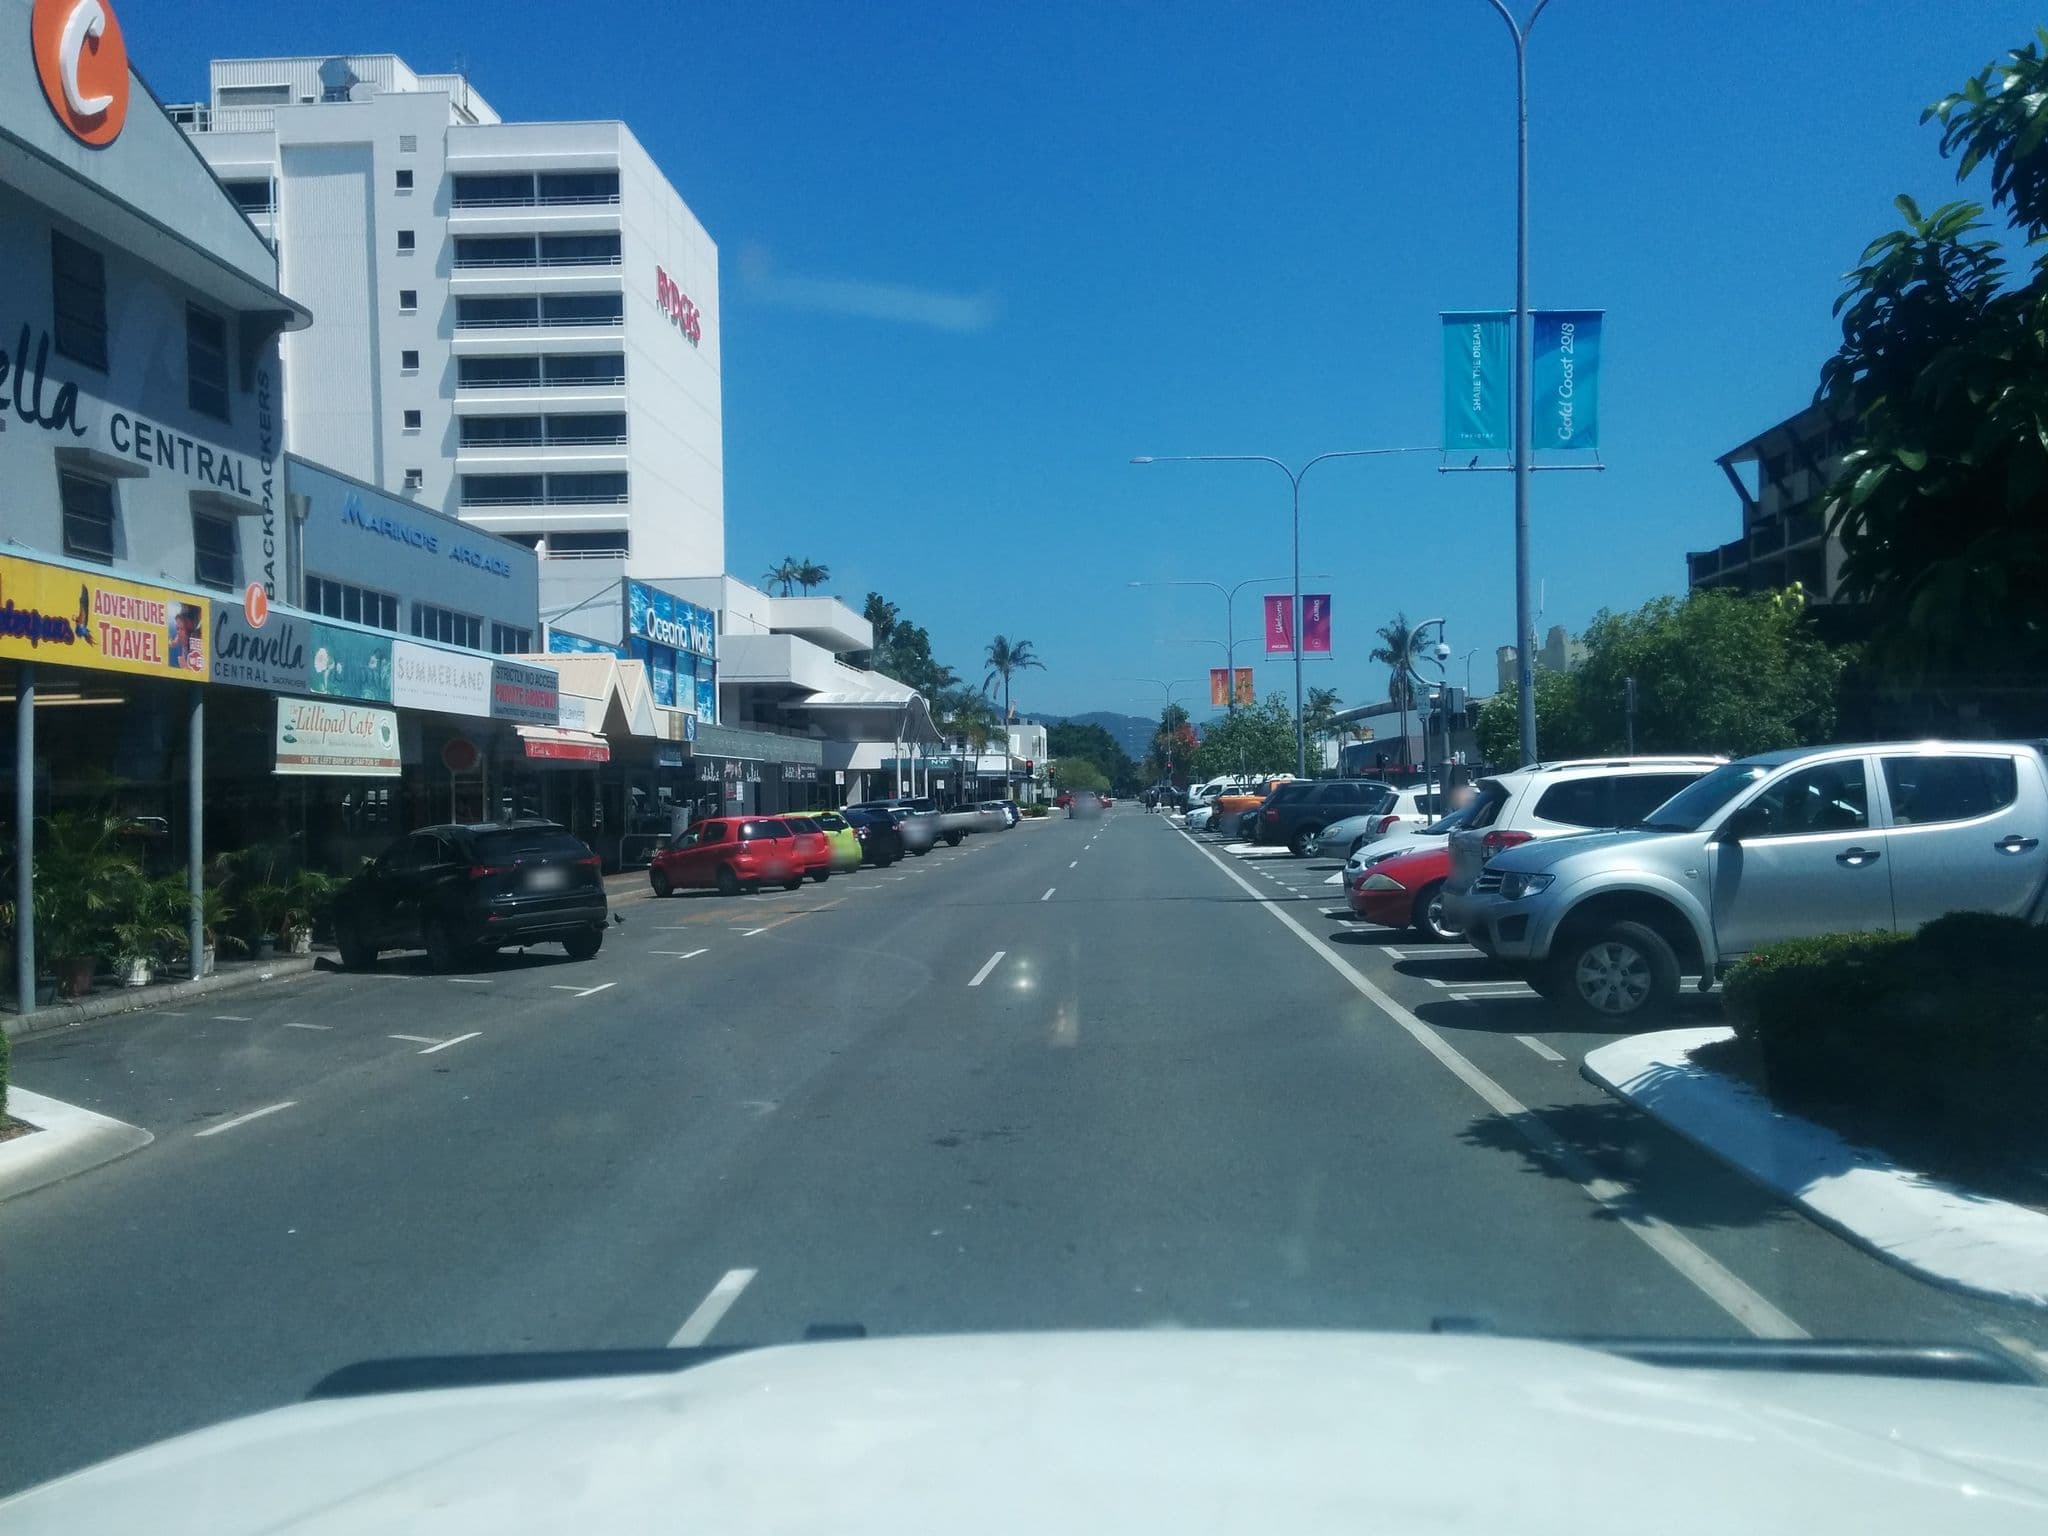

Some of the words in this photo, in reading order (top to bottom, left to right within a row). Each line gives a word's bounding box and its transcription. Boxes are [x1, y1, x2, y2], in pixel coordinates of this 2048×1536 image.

[656, 264, 701, 343] RYDGES
[1472, 323, 1481, 358] DREAM
[1560, 322, 1575, 354] 2018
[1472, 358, 1481, 378] THE
[1558, 356, 1574, 399] Coast
[1472, 380, 1481, 412] SHARE
[1558, 402, 1573, 440] Gold
[110, 413, 251, 497] CENTRAL
[257, 369, 275, 600] BACKPACKERS
[449, 544, 513, 578] ARCADE
[94, 589, 166, 626] ADVENTURE
[99, 621, 162, 664] TRAVEL
[215, 611, 304, 670] Caravella
[689, 622, 712, 654] Walk
[215, 663, 268, 683] CENTRAL
[397, 656, 485, 690] SUMMERLAND
[295, 705, 346, 744] Lillipad
[349, 710, 376, 738] Café
